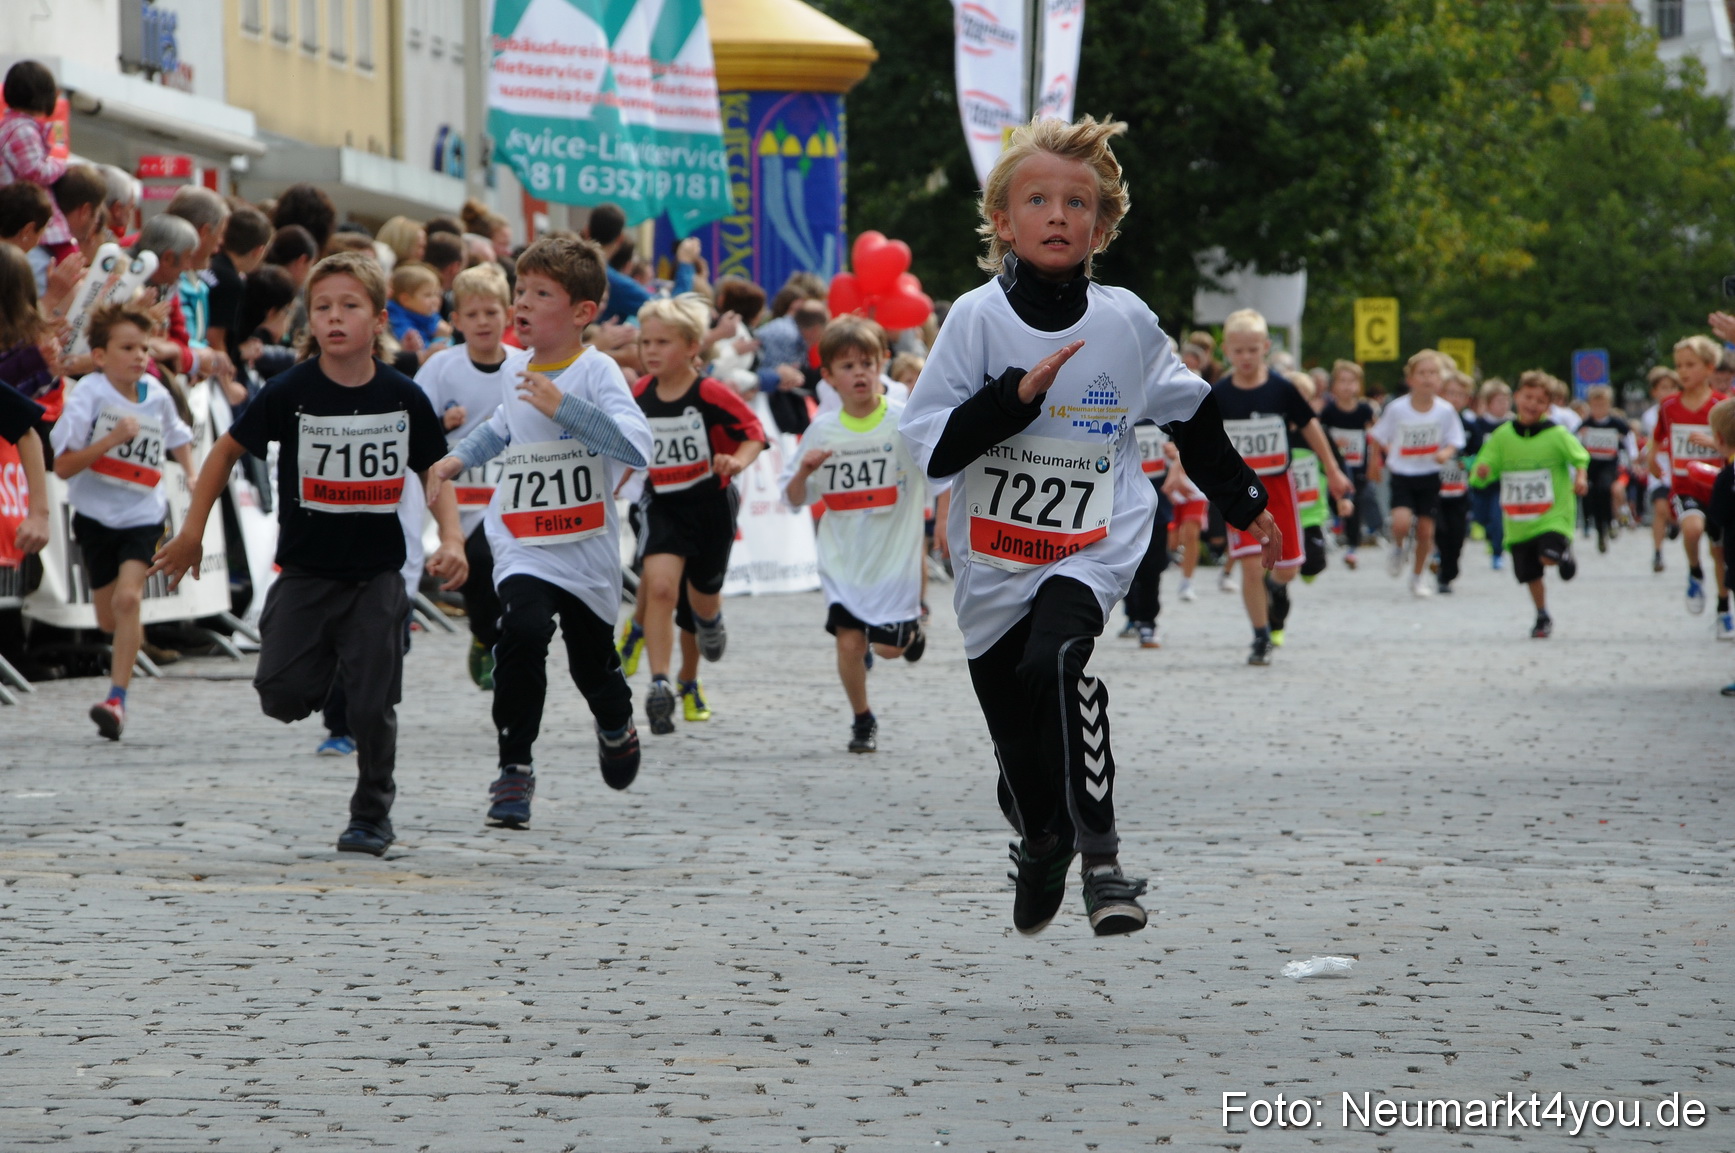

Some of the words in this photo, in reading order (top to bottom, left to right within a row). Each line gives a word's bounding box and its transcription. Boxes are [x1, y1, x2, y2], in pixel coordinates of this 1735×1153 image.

[1366, 316, 1387, 347] C
[1048, 405, 1071, 419] 14.
[1067, 405, 1105, 413] Neumarkter
[302, 425, 338, 436] PARTL
[342, 424, 392, 436] Neumarkt
[106, 427, 161, 467] 343
[312, 440, 398, 478] 7165
[504, 455, 528, 466] ARTL
[531, 449, 583, 463] Neumarkt
[654, 435, 698, 465] 246
[1021, 449, 1091, 470] Neumarkt
[508, 465, 592, 508] 7210
[823, 458, 887, 491] 7347
[314, 484, 402, 501] Maximilian
[984, 466, 1095, 529] 7227
[535, 514, 573, 532] Felix
[973, 505, 979, 515] 4
[990, 529, 1080, 561] Jonathan
